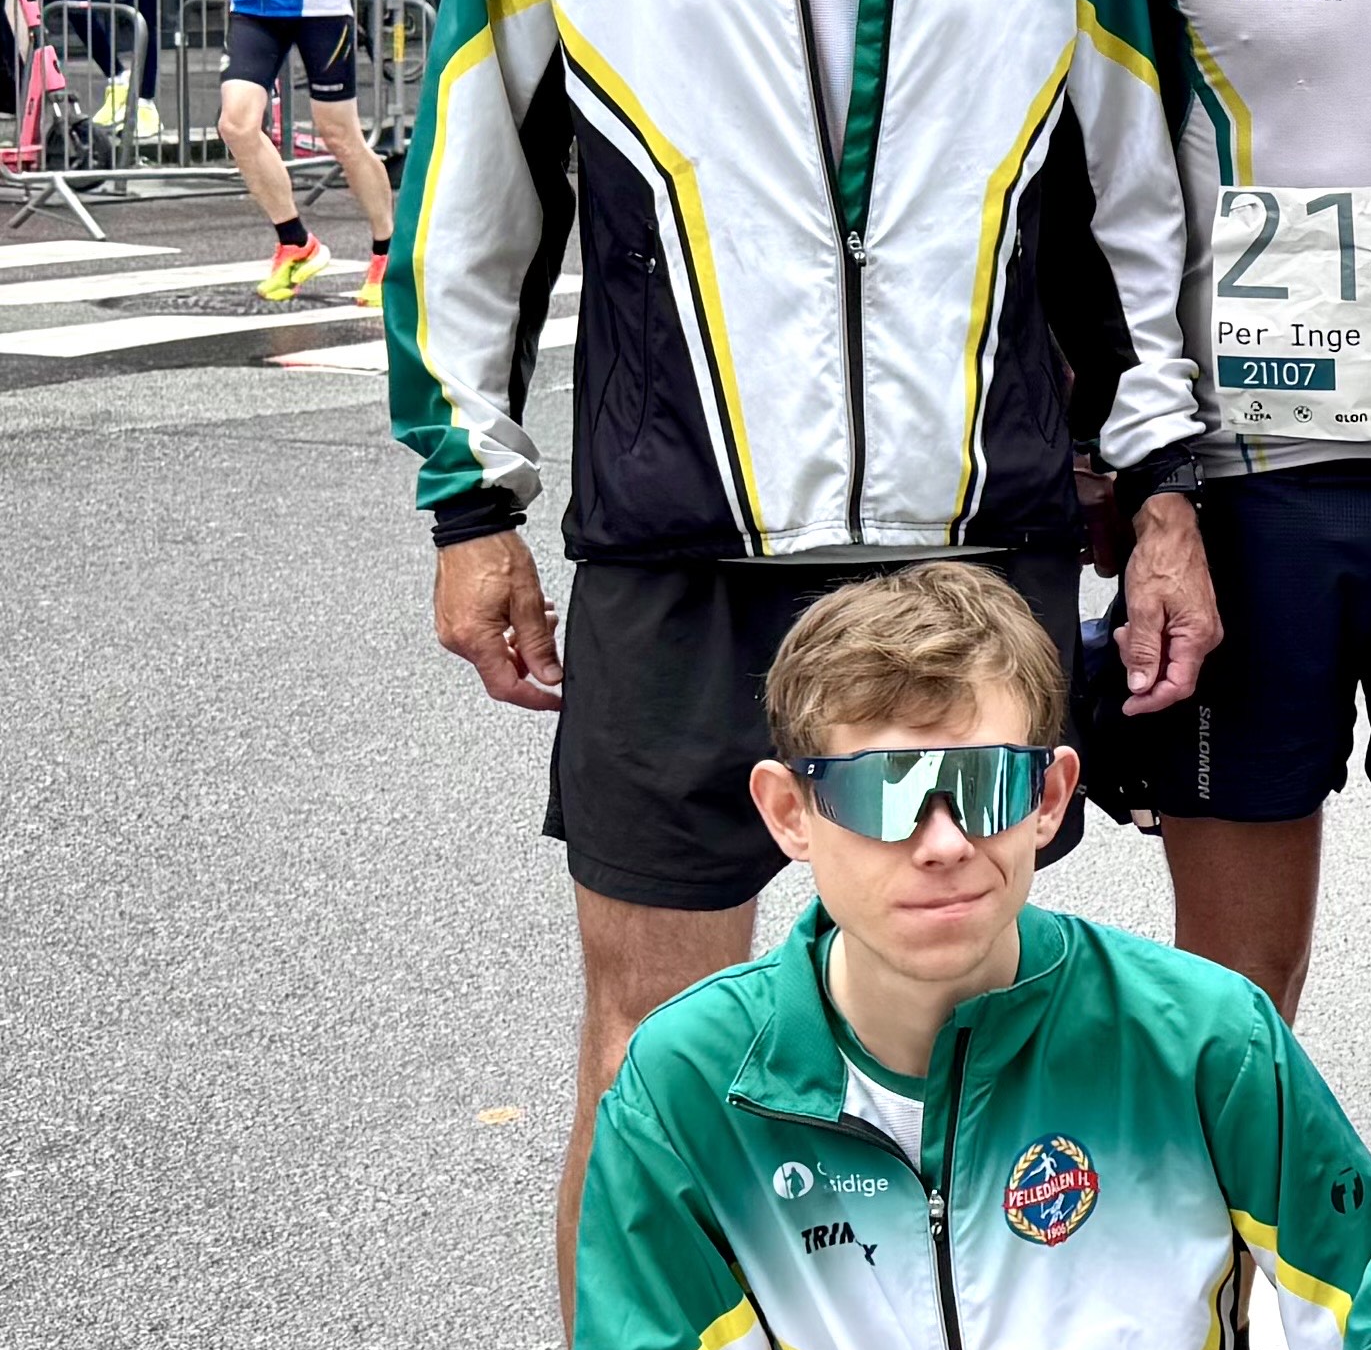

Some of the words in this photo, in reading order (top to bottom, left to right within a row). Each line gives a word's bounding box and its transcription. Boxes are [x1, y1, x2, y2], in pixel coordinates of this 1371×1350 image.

[1217, 190, 1357, 302] 21
[1218, 321, 1269, 346] Per
[1291, 323, 1361, 352] Inge
[1243, 362, 1316, 387] 21107
[1198, 705, 1212, 800] SALOMON
[1008, 1175, 1077, 1209] VELLEDALEN
